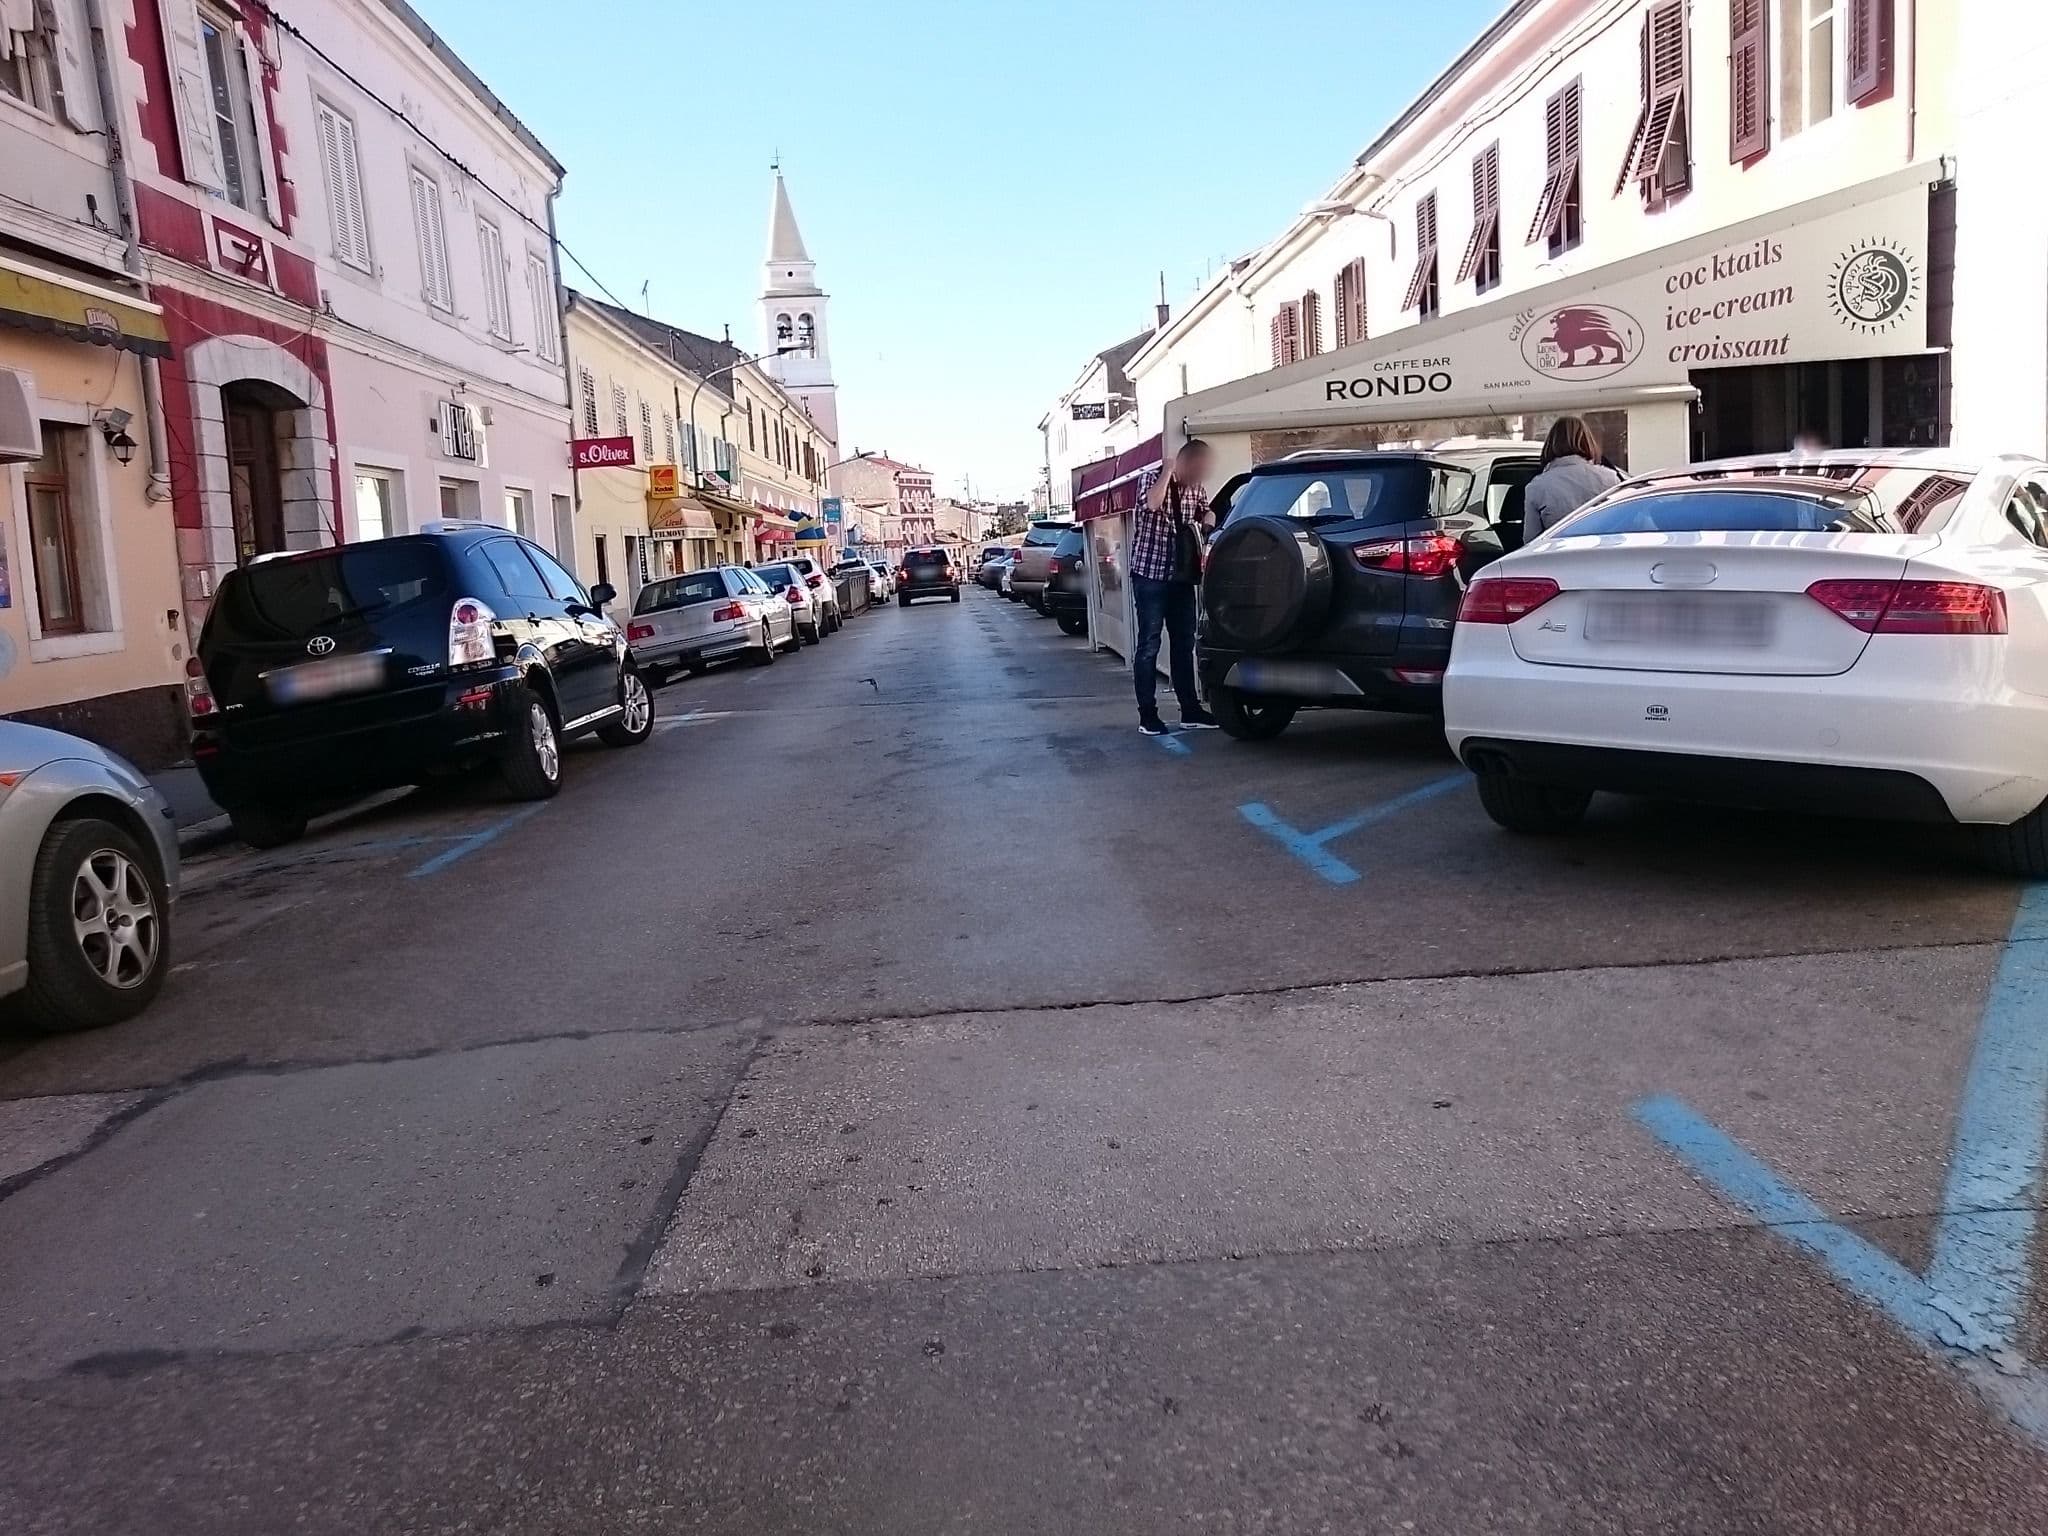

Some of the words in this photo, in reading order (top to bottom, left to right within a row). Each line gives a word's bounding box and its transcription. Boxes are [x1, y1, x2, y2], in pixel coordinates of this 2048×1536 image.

[1665, 286, 1794, 331] ice-cream
[1668, 333, 1791, 363] croissant
[1373, 359, 1420, 372] CAFFE
[1423, 357, 1451, 368] BAR
[1326, 372, 1453, 401] RONDO
[1483, 382, 1500, 390] SAN
[1502, 379, 1531, 389] MARCO
[580, 444, 630, 464] s.Oliver
[1538, 618, 1567, 632] A5
